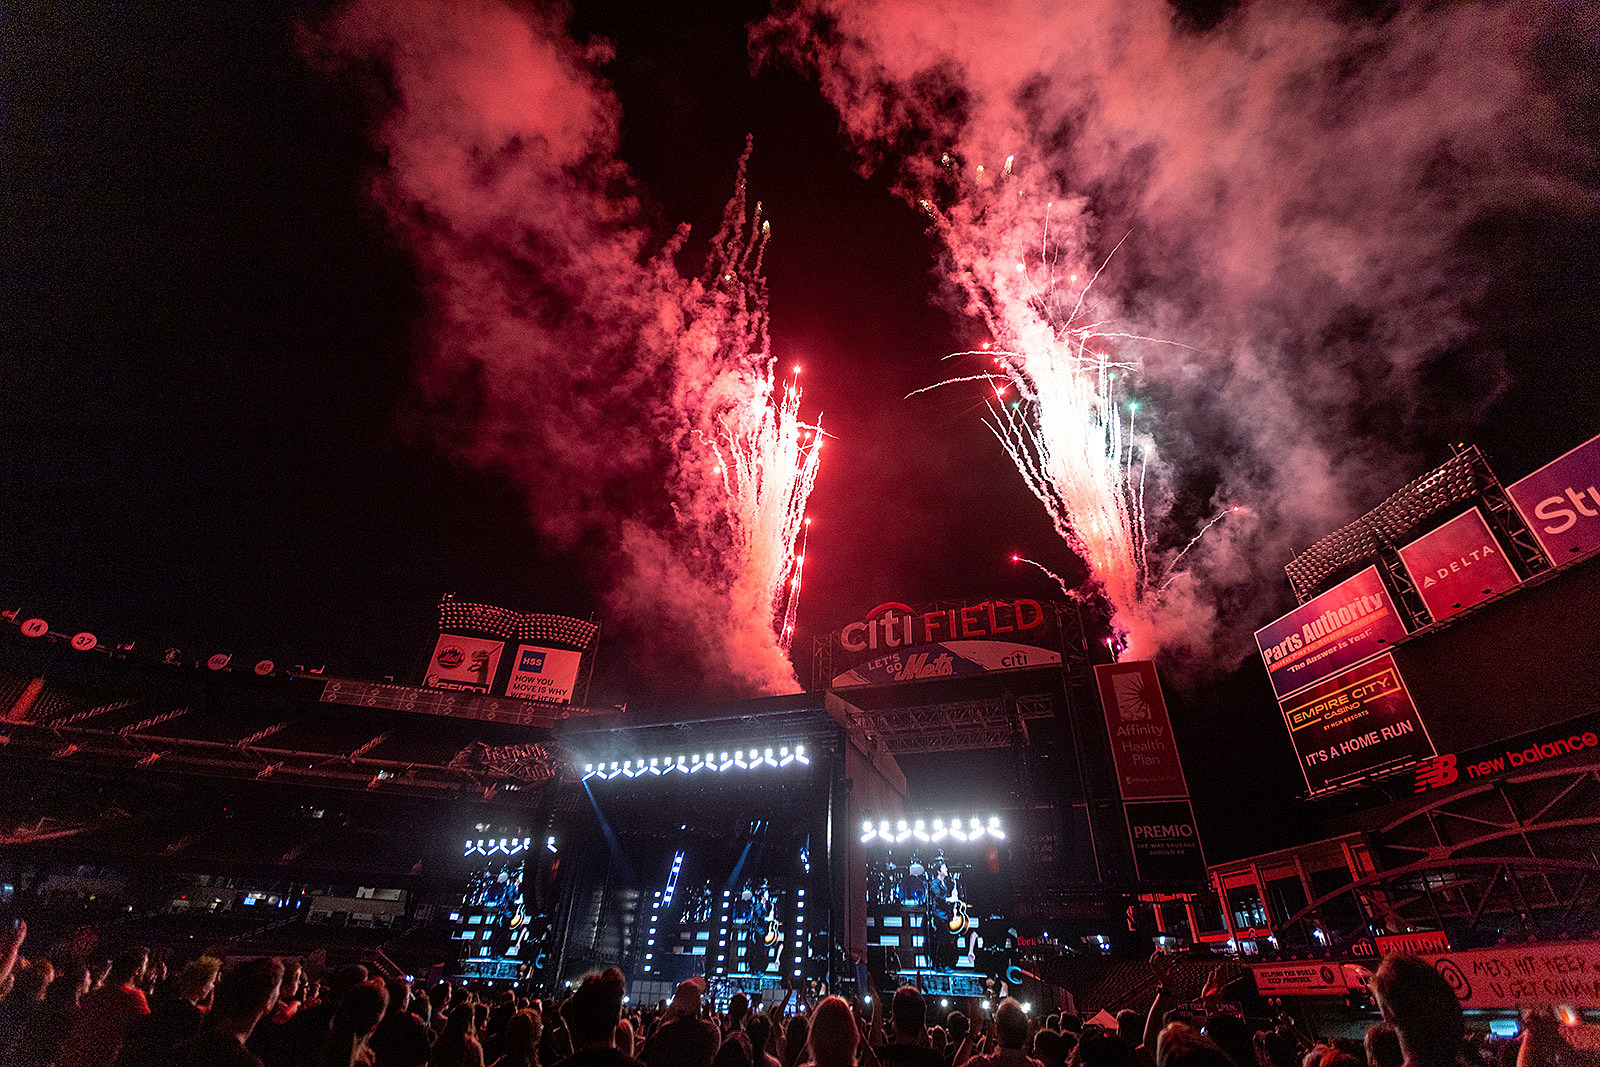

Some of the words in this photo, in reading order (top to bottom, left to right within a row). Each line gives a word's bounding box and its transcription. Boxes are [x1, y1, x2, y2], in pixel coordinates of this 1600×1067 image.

[1437, 545, 1495, 579] DELTA
[28, 623, 42, 632] 14
[924, 598, 1044, 642] FIELD
[1263, 633, 1303, 665] Parts
[1302, 592, 1384, 645] Authority
[76, 637, 93, 646] 37
[522, 656, 543, 667] HSS
[867, 653, 901, 671] LET'S
[1306, 645, 1338, 664] Answer
[886, 662, 903, 675] GO
[894, 652, 954, 681] Mets
[515, 675, 535, 684] HOW
[537, 678, 554, 686] YOU
[513, 683, 537, 692] MOVE
[548, 688, 568, 696] WHY
[1293, 694, 1350, 724] EMPIRE
[1351, 677, 1389, 699] CITY
[1324, 701, 1361, 720] CASINO
[1343, 709, 1370, 723] RESORTS
[1117, 723, 1164, 737] Affinity
[1121, 739, 1165, 752] Health
[1305, 749, 1328, 767] IT'S
[1330, 745, 1340, 759] A
[1339, 730, 1381, 755] HOME
[1381, 719, 1414, 741] RUN
[1132, 753, 1161, 766] Plan
[1467, 756, 1505, 779] new
[1507, 732, 1598, 768] balance
[1133, 824, 1193, 839] PREMIO
[1382, 937, 1446, 954] PAVILION
[1473, 959, 1511, 978] METS
[1515, 957, 1537, 977] HIT
[1489, 982, 1505, 999] U
[1510, 980, 1538, 999] GET
